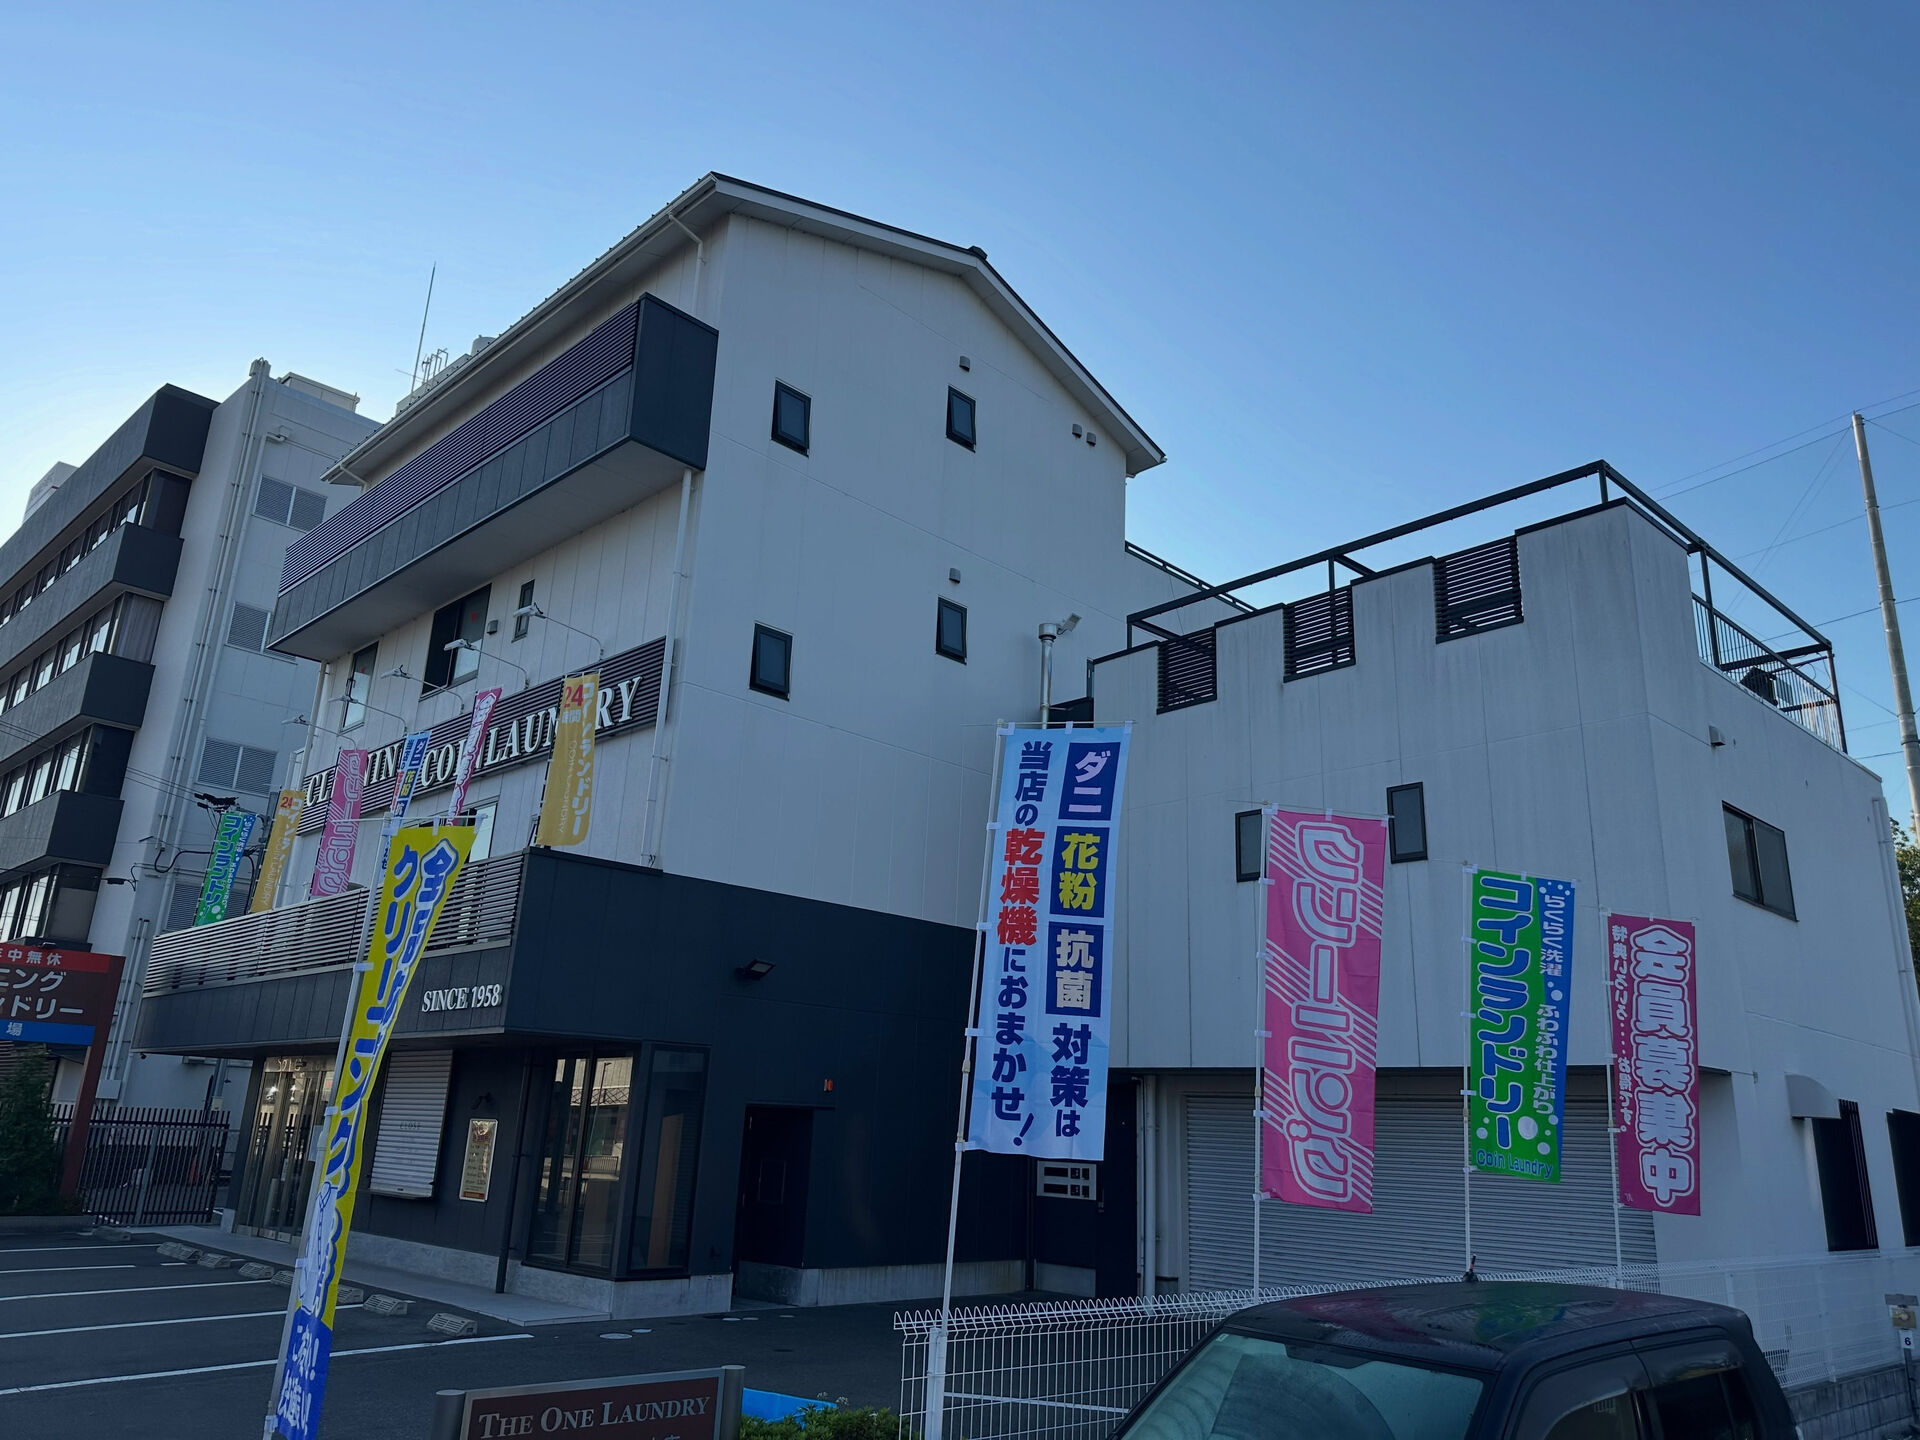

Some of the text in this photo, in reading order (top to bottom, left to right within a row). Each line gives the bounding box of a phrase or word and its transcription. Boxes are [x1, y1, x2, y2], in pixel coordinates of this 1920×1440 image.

[484, 676, 643, 767] LAUNRY
[0, 948, 62, 966] 中無休
[0, 995, 84, 1019] ドリー
[422, 983, 503, 1012] SINCE 1958
[1477, 876, 1533, 1149] コインランドリー
[1476, 1149, 1553, 1180] Coin Laundry
[1904, 1337, 1912, 1346] 6
